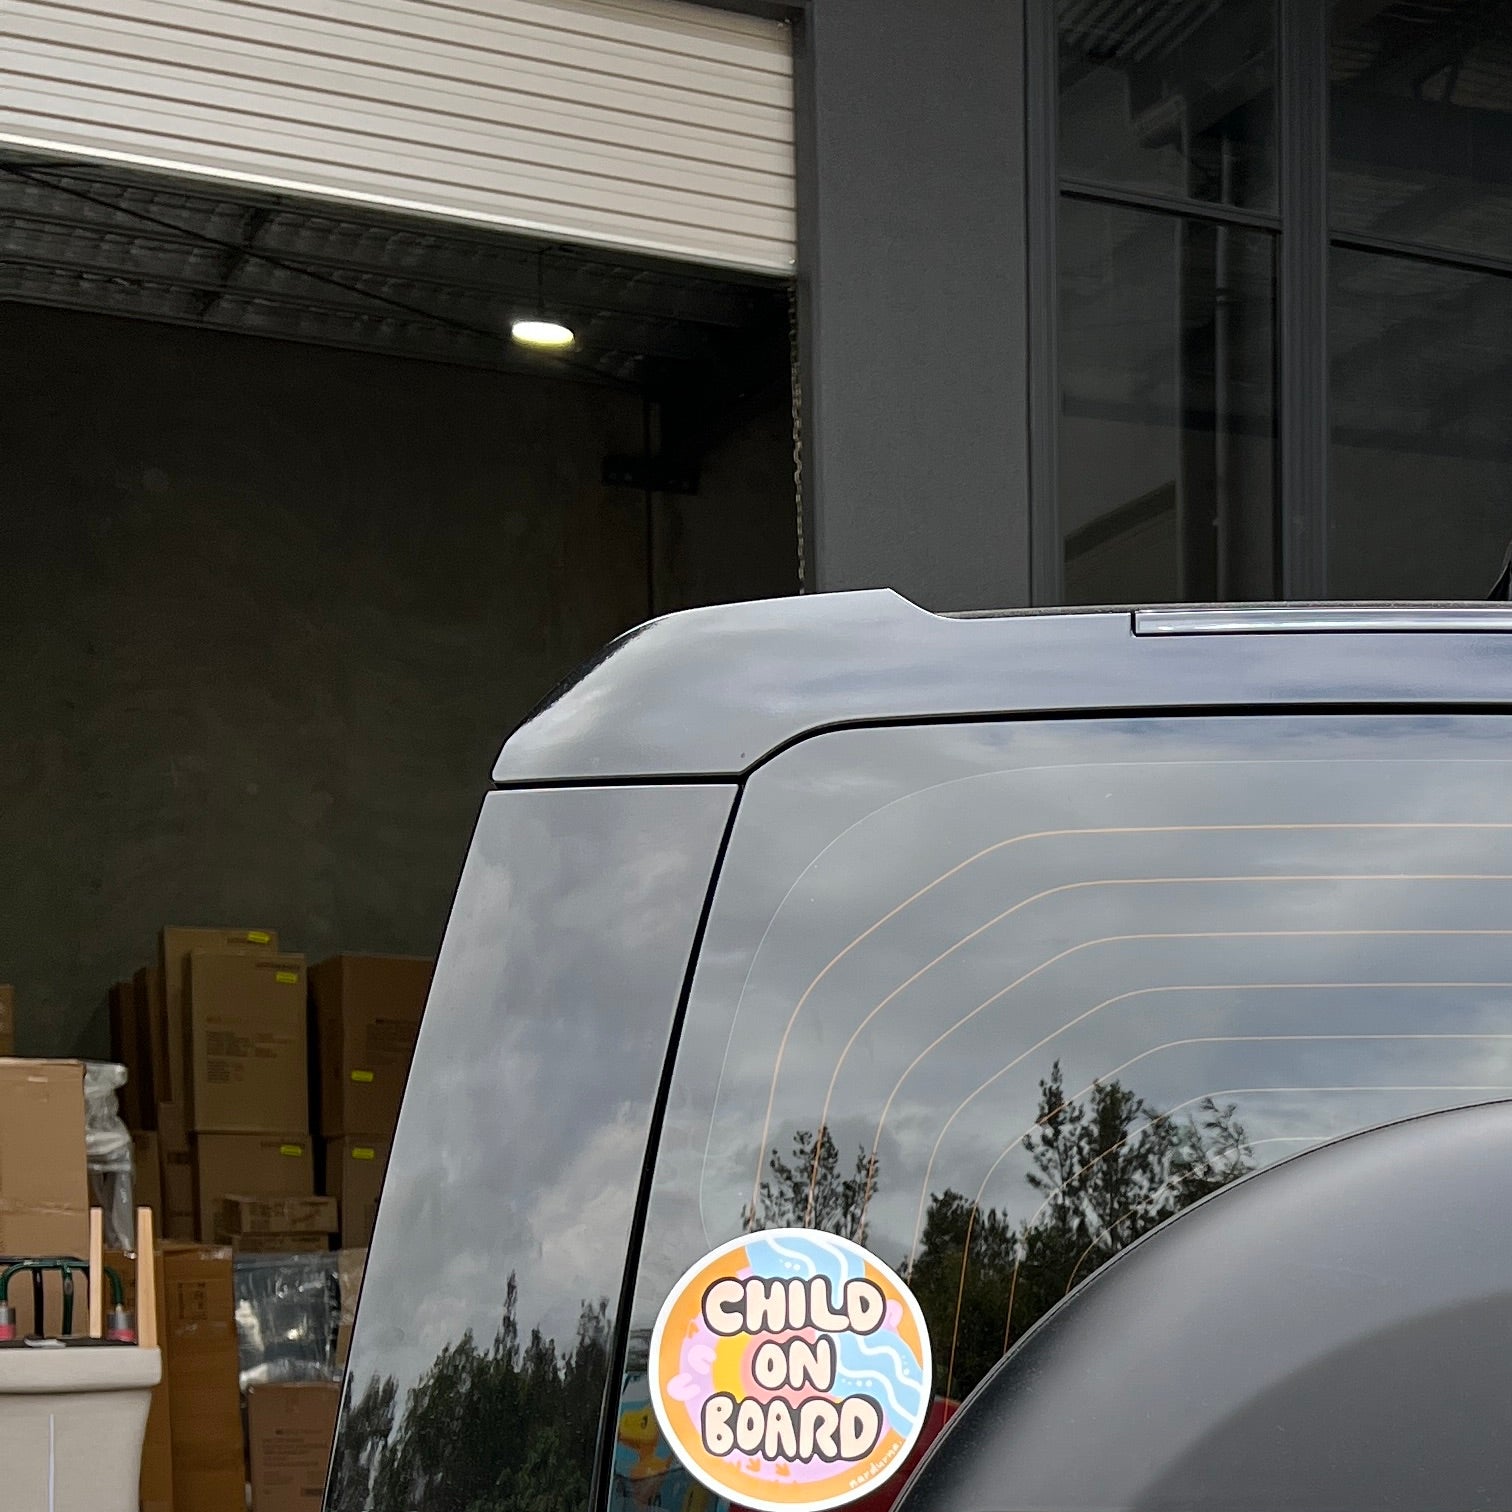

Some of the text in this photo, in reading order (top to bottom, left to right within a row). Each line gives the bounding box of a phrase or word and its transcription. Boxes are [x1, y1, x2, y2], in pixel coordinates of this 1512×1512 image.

[702, 1275, 887, 1336] CHILD
[752, 1334, 838, 1393] ON
[700, 1391, 884, 1463] BOARD
